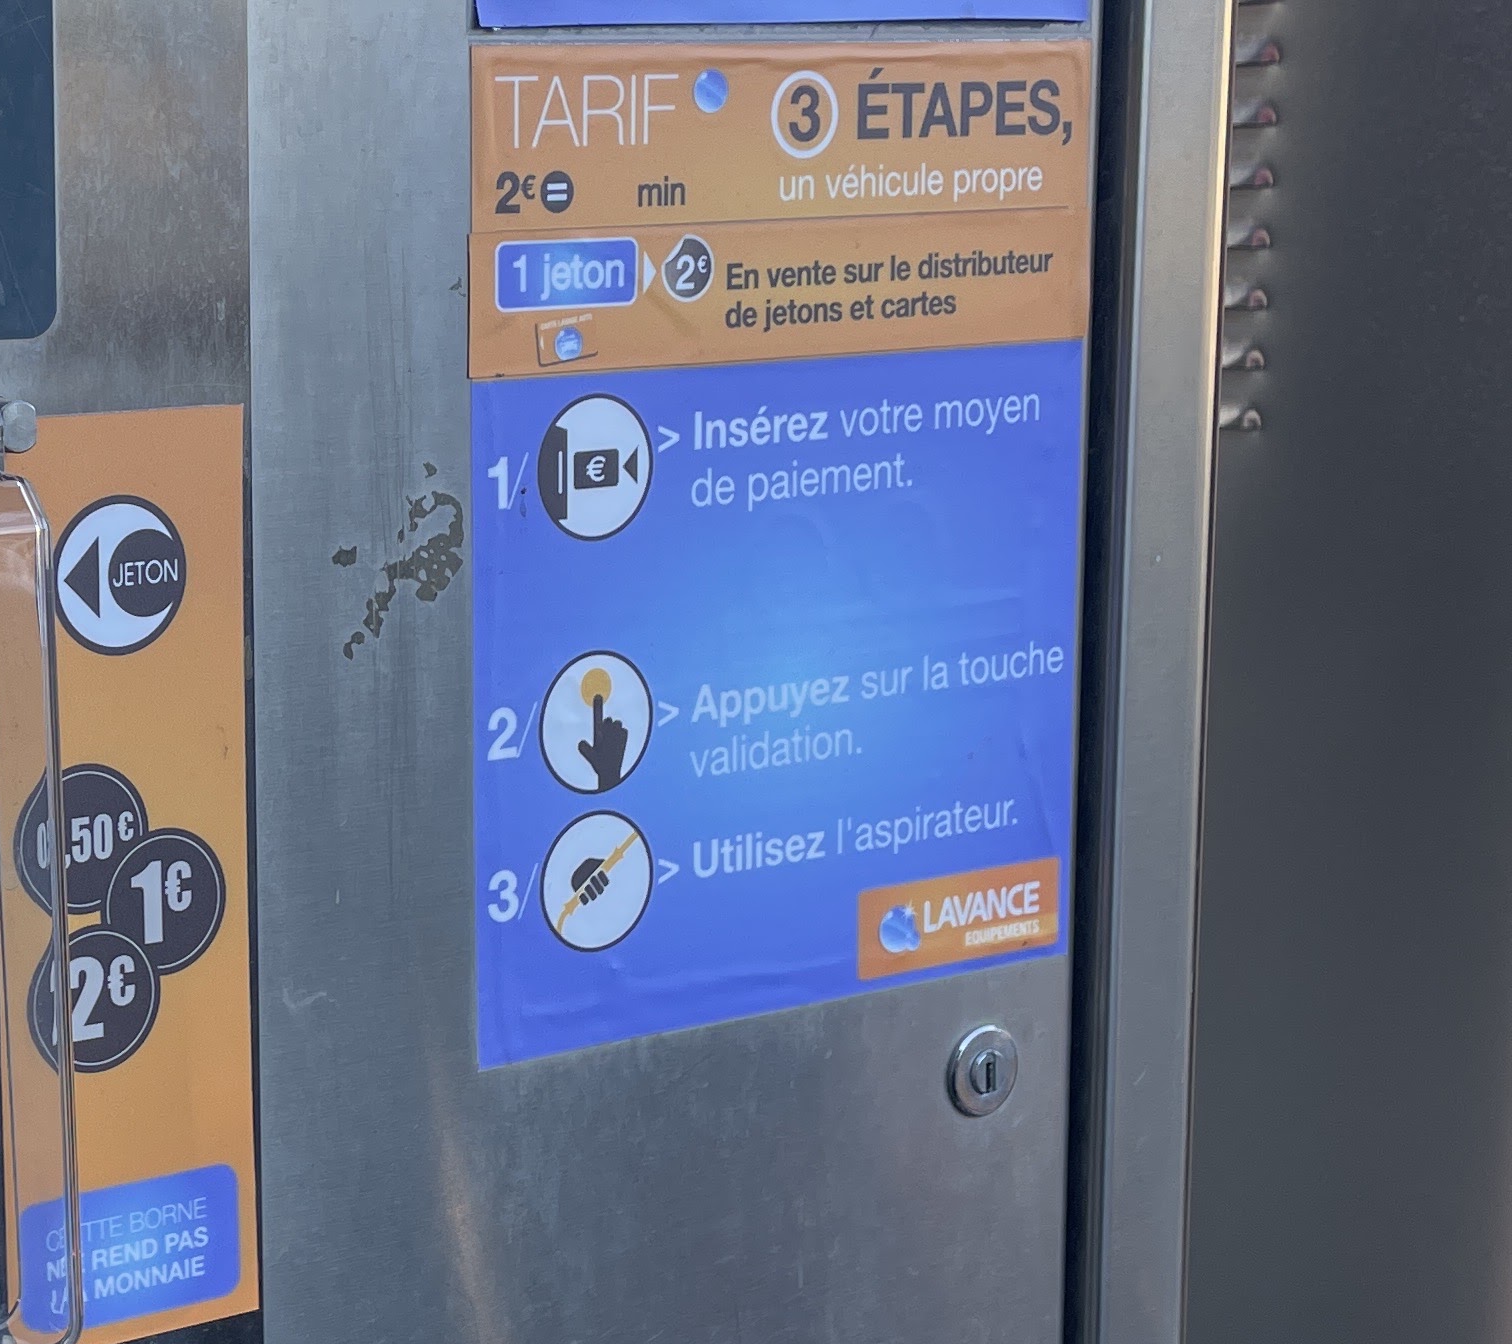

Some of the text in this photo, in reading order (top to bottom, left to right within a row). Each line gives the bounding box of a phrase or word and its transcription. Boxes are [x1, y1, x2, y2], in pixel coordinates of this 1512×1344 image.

[495, 73, 679, 149] TARIF
[788, 67, 1072, 146] 3 ÉTAPES,
[495, 171, 536, 214] 2€
[638, 176, 686, 207] min
[779, 162, 1043, 203] un véhicule propre
[512, 253, 625, 301] 1 jeton
[676, 254, 708, 291] 2€
[726, 250, 1054, 290] En vente sur le distributeur
[725, 291, 957, 333] de jetons et cartes
[693, 391, 1040, 452] Insérez votre moyen
[691, 454, 914, 511] de paiement.
[112, 558, 179, 589] JETON
[691, 641, 1064, 728] Appuyez sur la touche
[690, 724, 863, 778] validation.
[693, 798, 1018, 878] Utilisez l'aspirateur.
[130, 859, 192, 944] 1€
[923, 881, 1040, 933] LAVANCE
[50, 955, 135, 1045] 2€
[130, 1197, 207, 1233] BORNE
[92, 1238, 158, 1271] REND
[165, 1226, 209, 1254] PAS
[94, 1255, 206, 1299] MONNAIE
